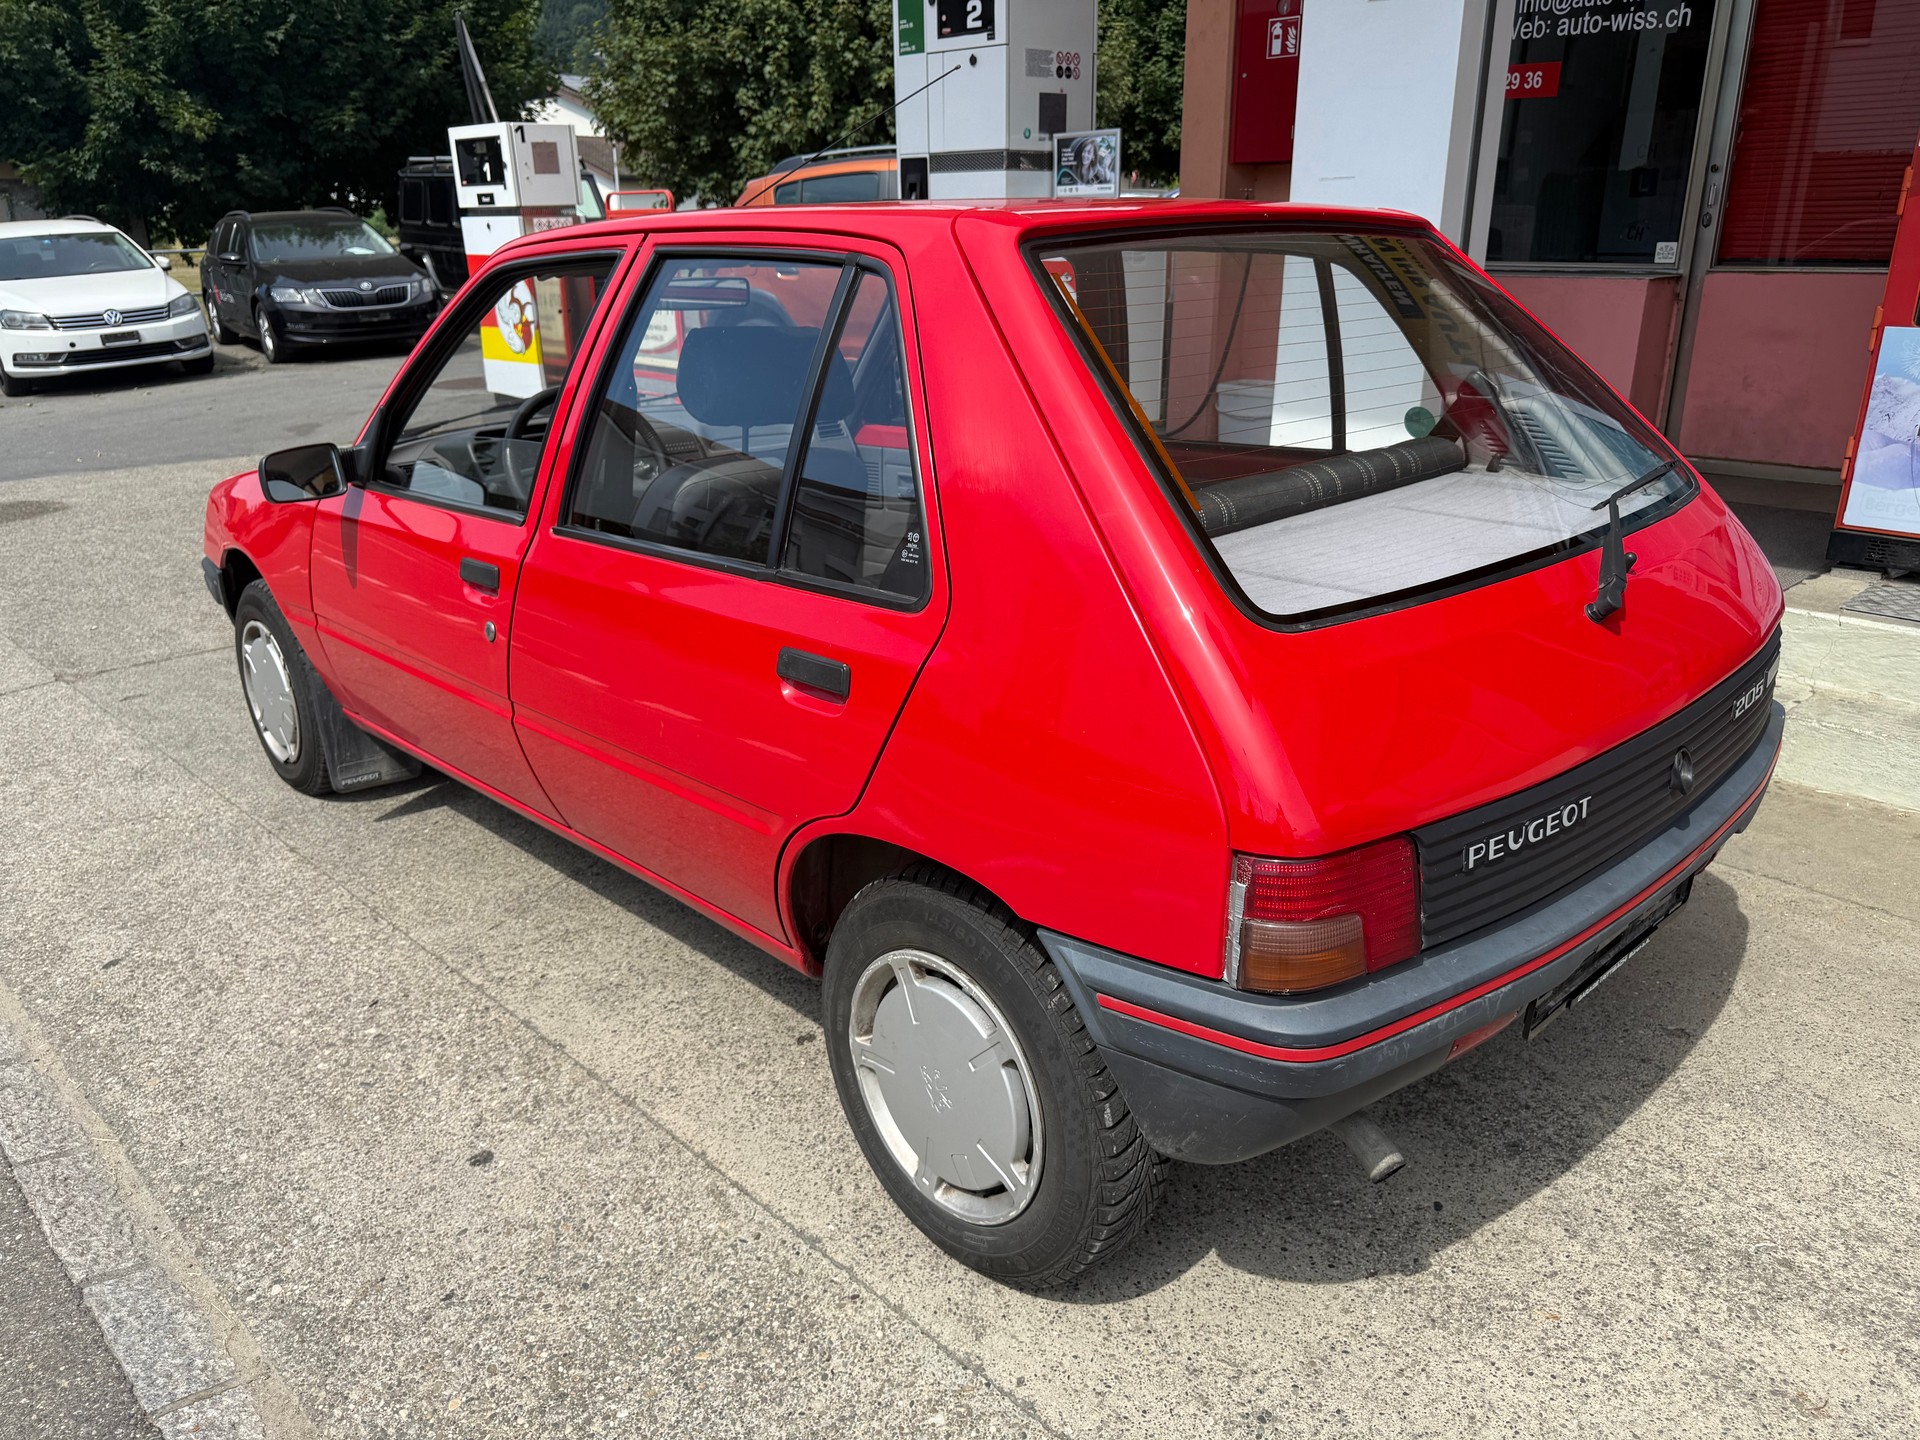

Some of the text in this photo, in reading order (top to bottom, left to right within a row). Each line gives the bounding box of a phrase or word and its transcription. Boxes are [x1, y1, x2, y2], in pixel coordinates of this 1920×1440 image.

[966, 0, 983, 29] 2
[1556, 2, 1692, 36] auto-wiss.ch
[1524, 71, 1543, 89] 36
[514, 125, 526, 143] 1
[482, 162, 491, 182] 1
[1735, 679, 1765, 718] 205
[1468, 795, 1592, 869] PEUGEOT
